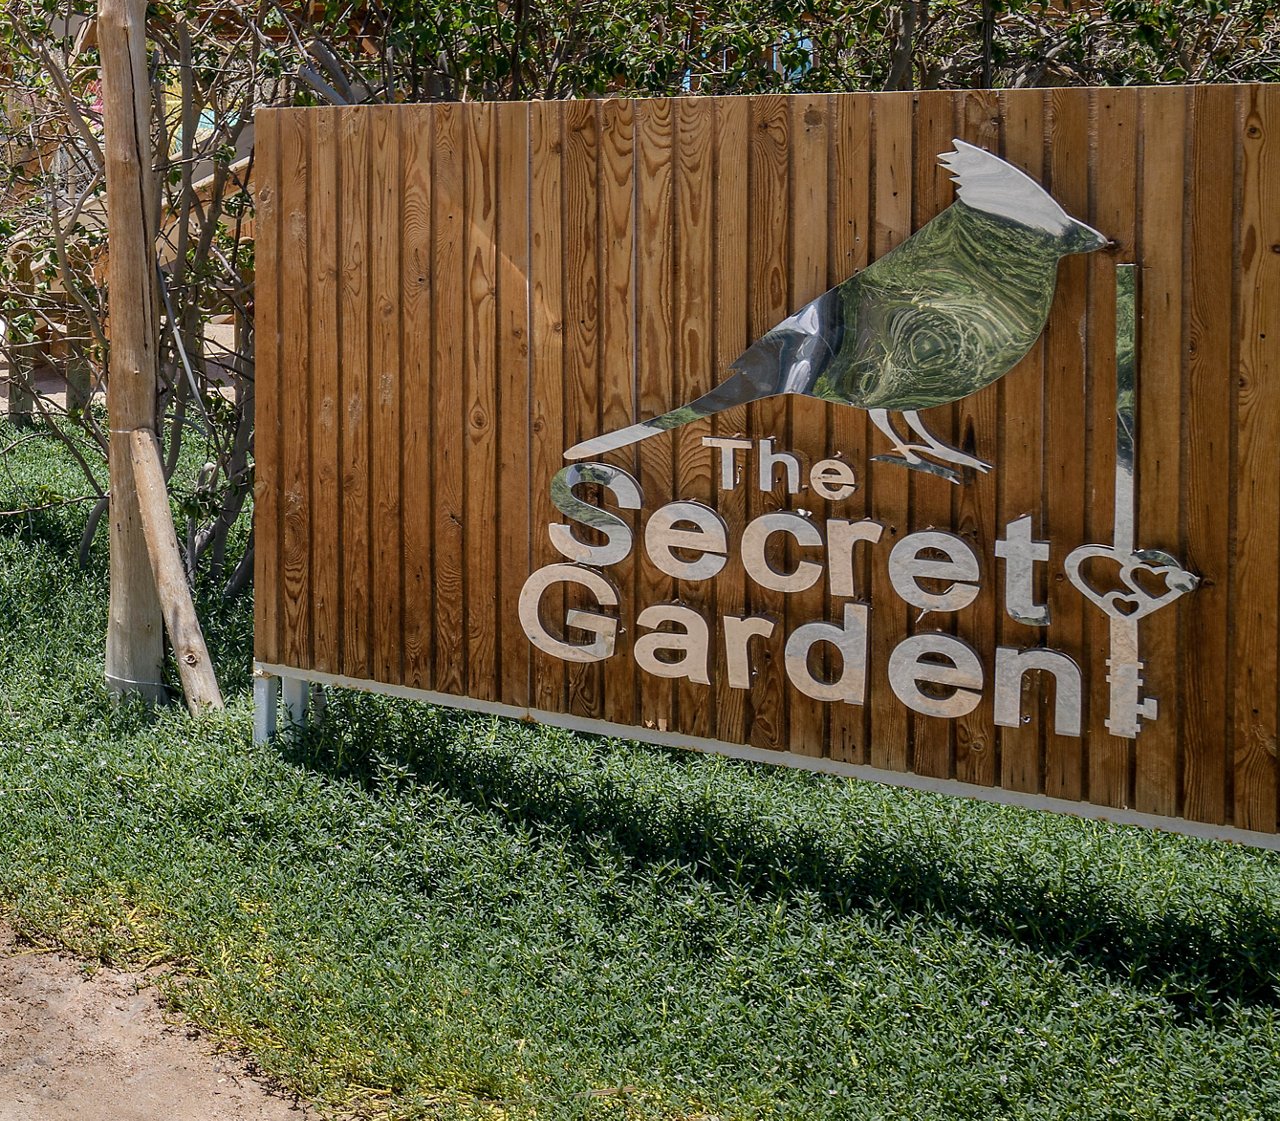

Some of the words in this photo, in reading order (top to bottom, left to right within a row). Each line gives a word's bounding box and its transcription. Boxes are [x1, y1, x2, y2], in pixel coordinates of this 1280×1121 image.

[548, 461, 1051, 627] Secret
[702, 436, 856, 501] The
[518, 562, 1082, 737] Garden
